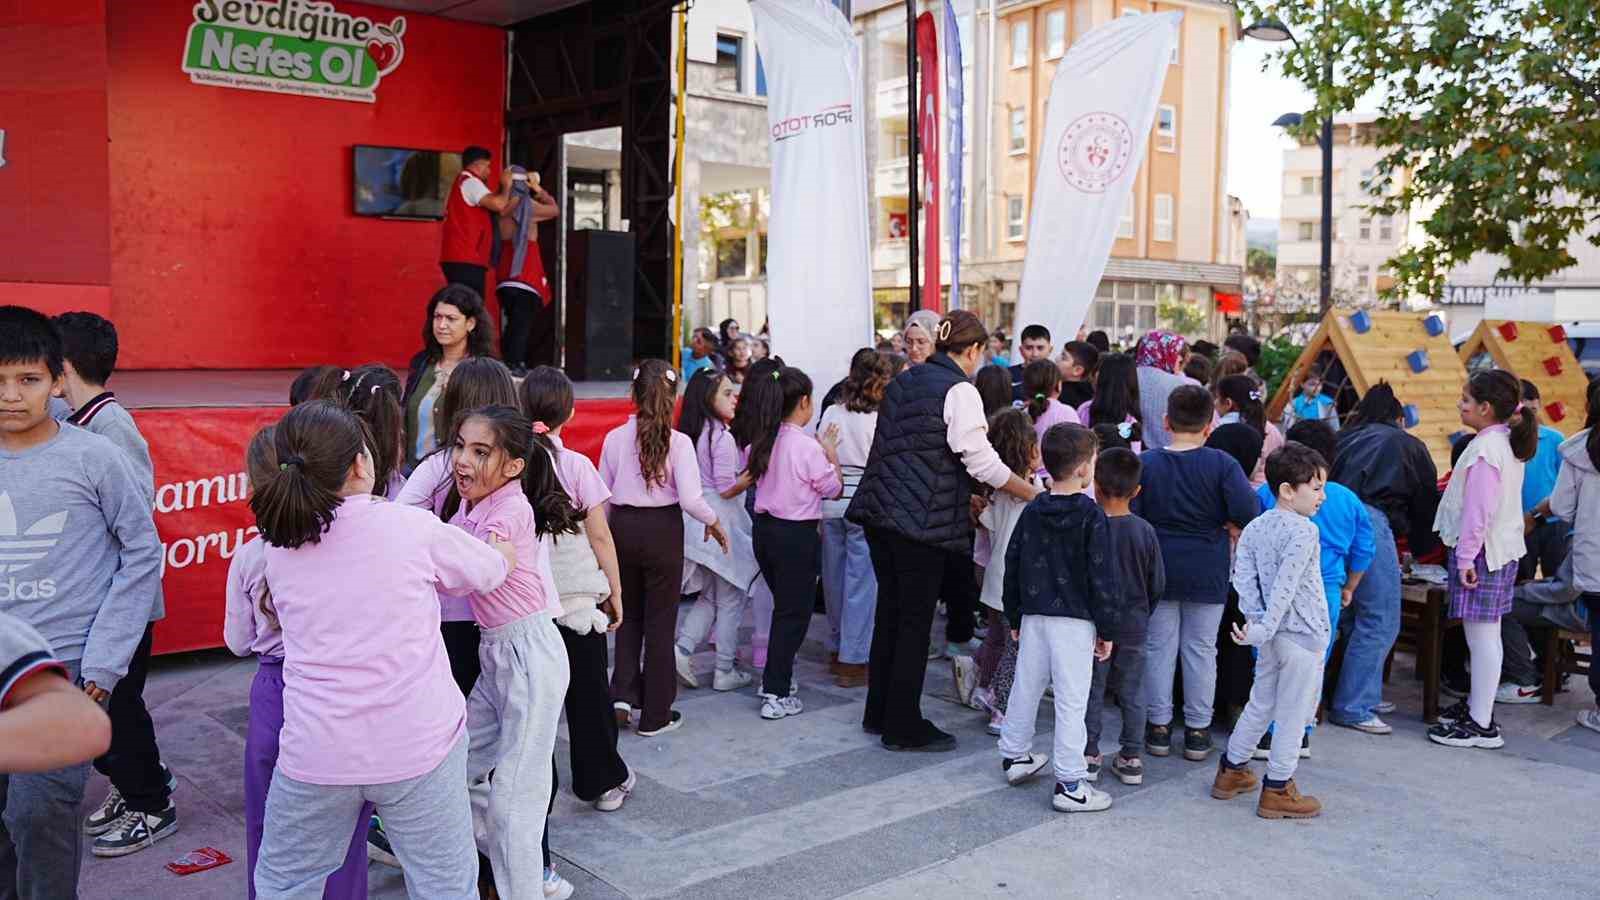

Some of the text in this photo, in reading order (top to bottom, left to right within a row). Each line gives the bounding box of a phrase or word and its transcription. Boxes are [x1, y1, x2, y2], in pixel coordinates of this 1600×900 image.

[200, 28, 364, 85] Nefes Ol
[152, 471, 250, 513] amı
[160, 525, 261, 579] oru
